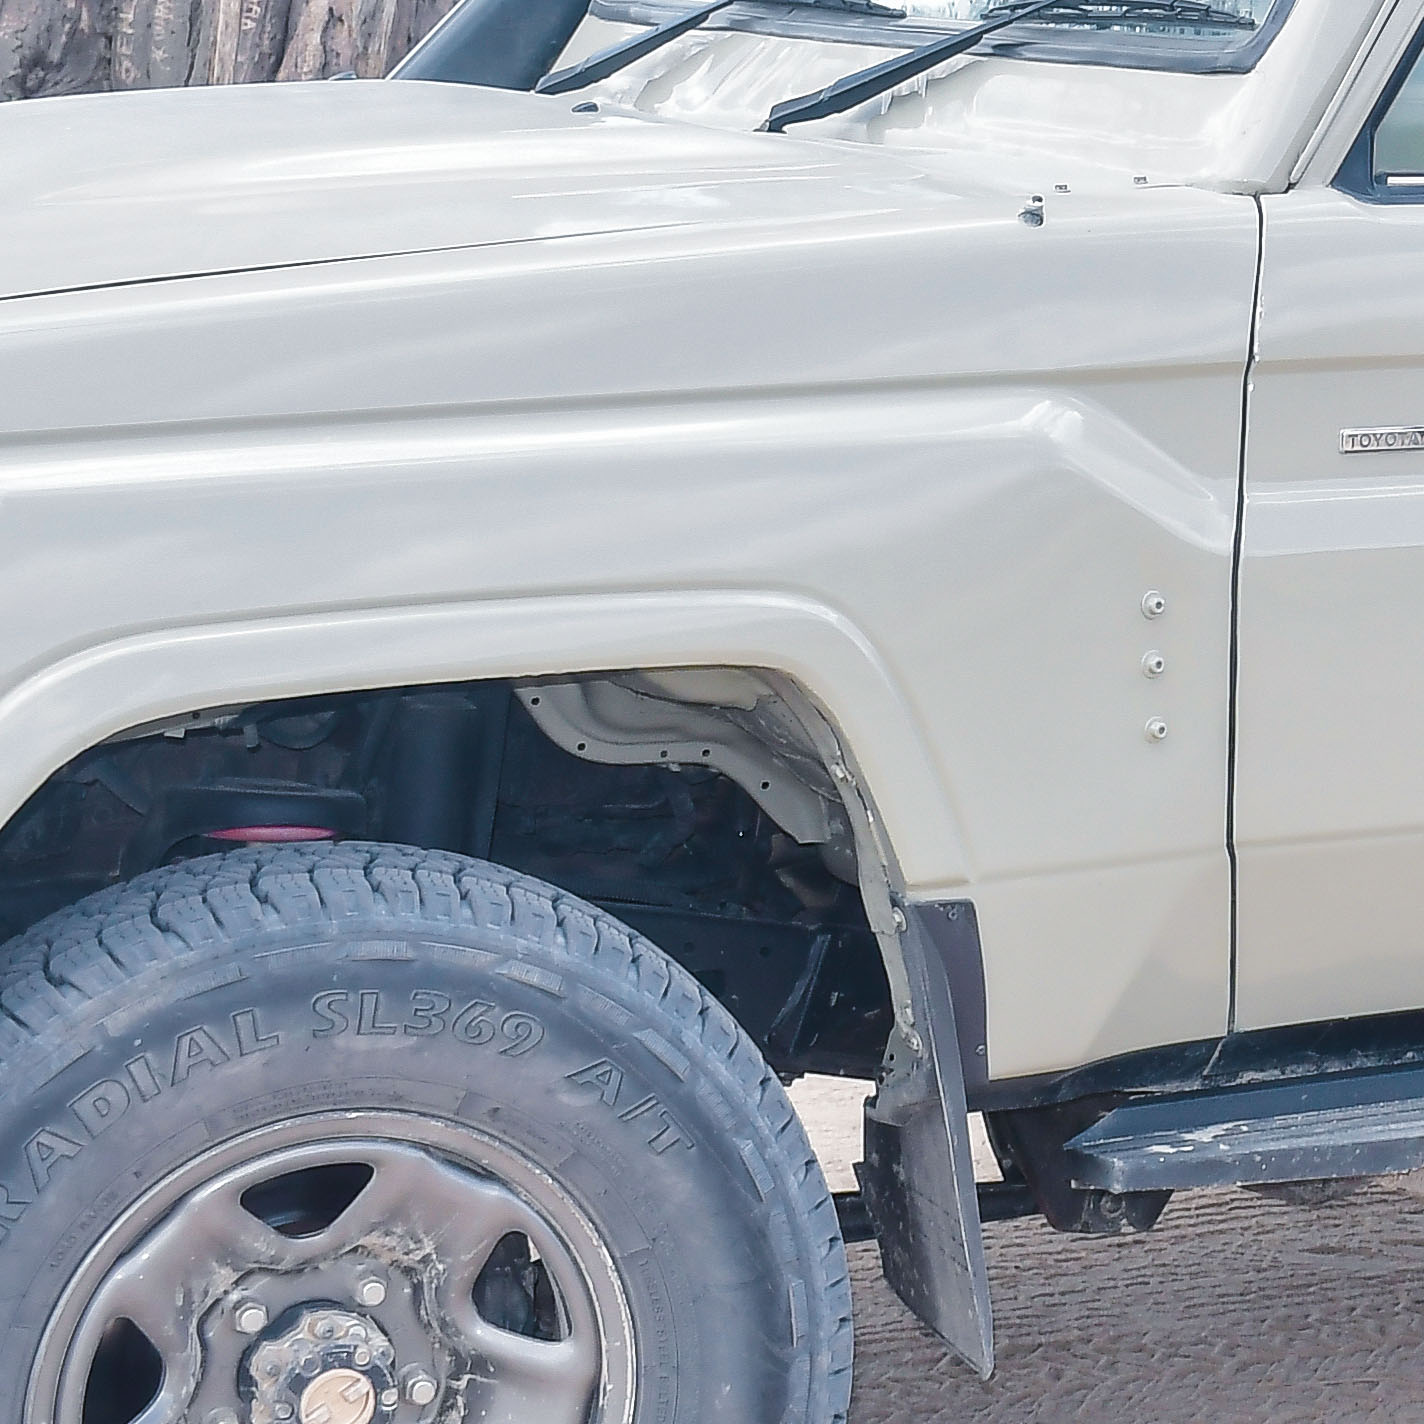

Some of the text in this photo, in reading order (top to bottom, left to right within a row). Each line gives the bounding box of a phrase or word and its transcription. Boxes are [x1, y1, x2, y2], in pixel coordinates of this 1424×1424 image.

[1348, 432, 1424, 448] TOYOTA
[310, 987, 548, 1058] SL369
[564, 1058, 696, 1157] A/T
